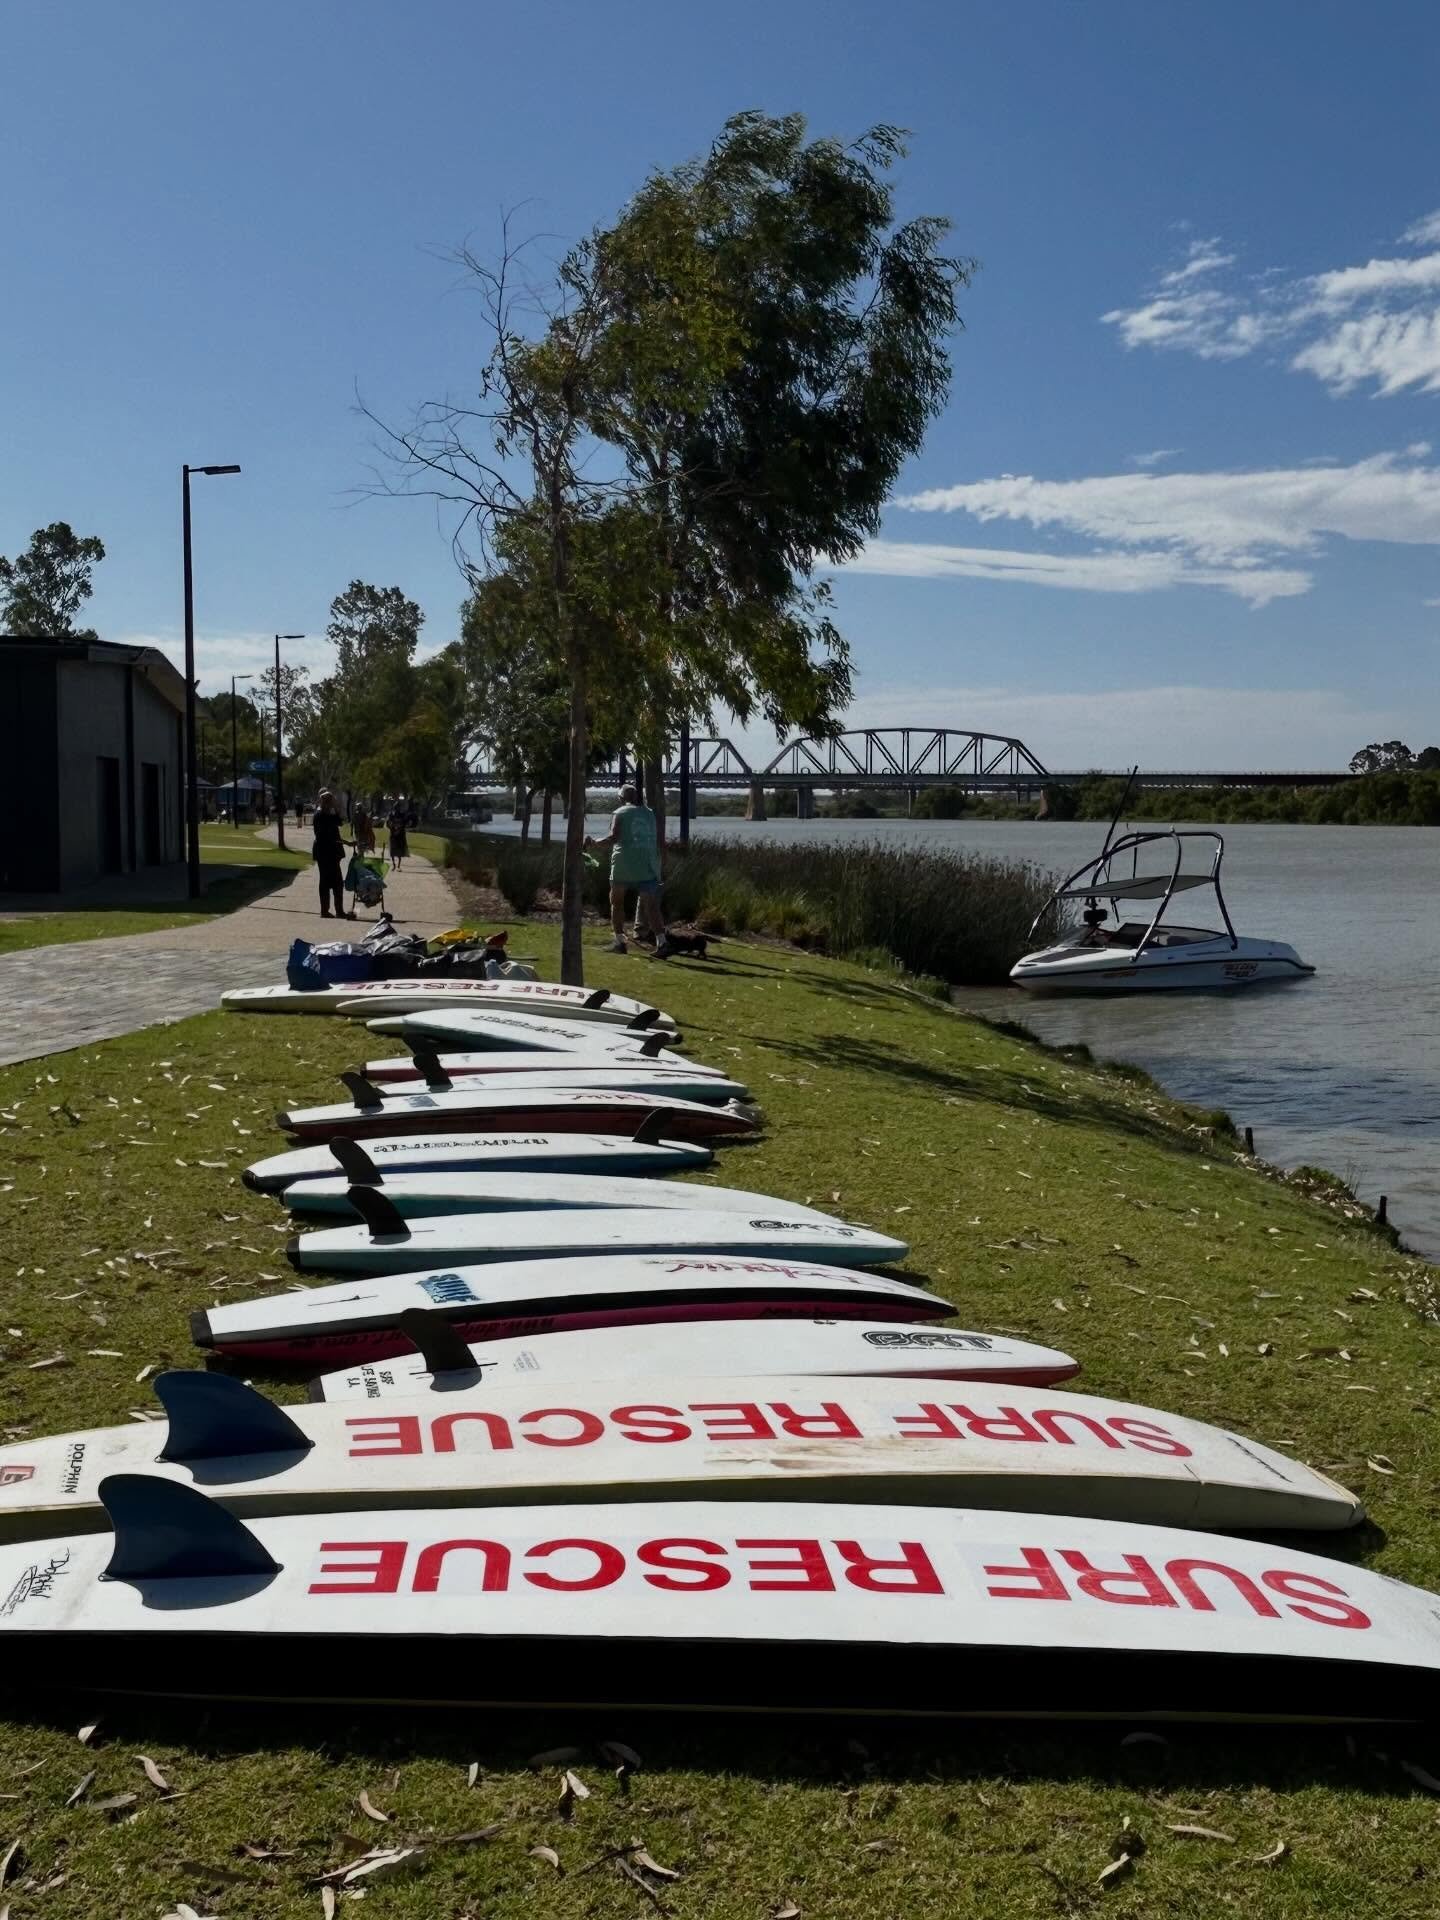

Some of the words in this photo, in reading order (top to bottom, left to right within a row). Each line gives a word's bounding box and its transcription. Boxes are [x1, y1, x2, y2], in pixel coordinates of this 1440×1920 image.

[340, 981, 500, 993] RESCUE
[510, 984, 590, 999] URF
[347, 1402, 863, 1457] RESCUE
[894, 1403, 1192, 1457] SURF
[64, 1443, 86, 1494] DOLPHIN
[308, 1538, 944, 1595] RESCUE
[983, 1547, 1372, 1630] SURF
